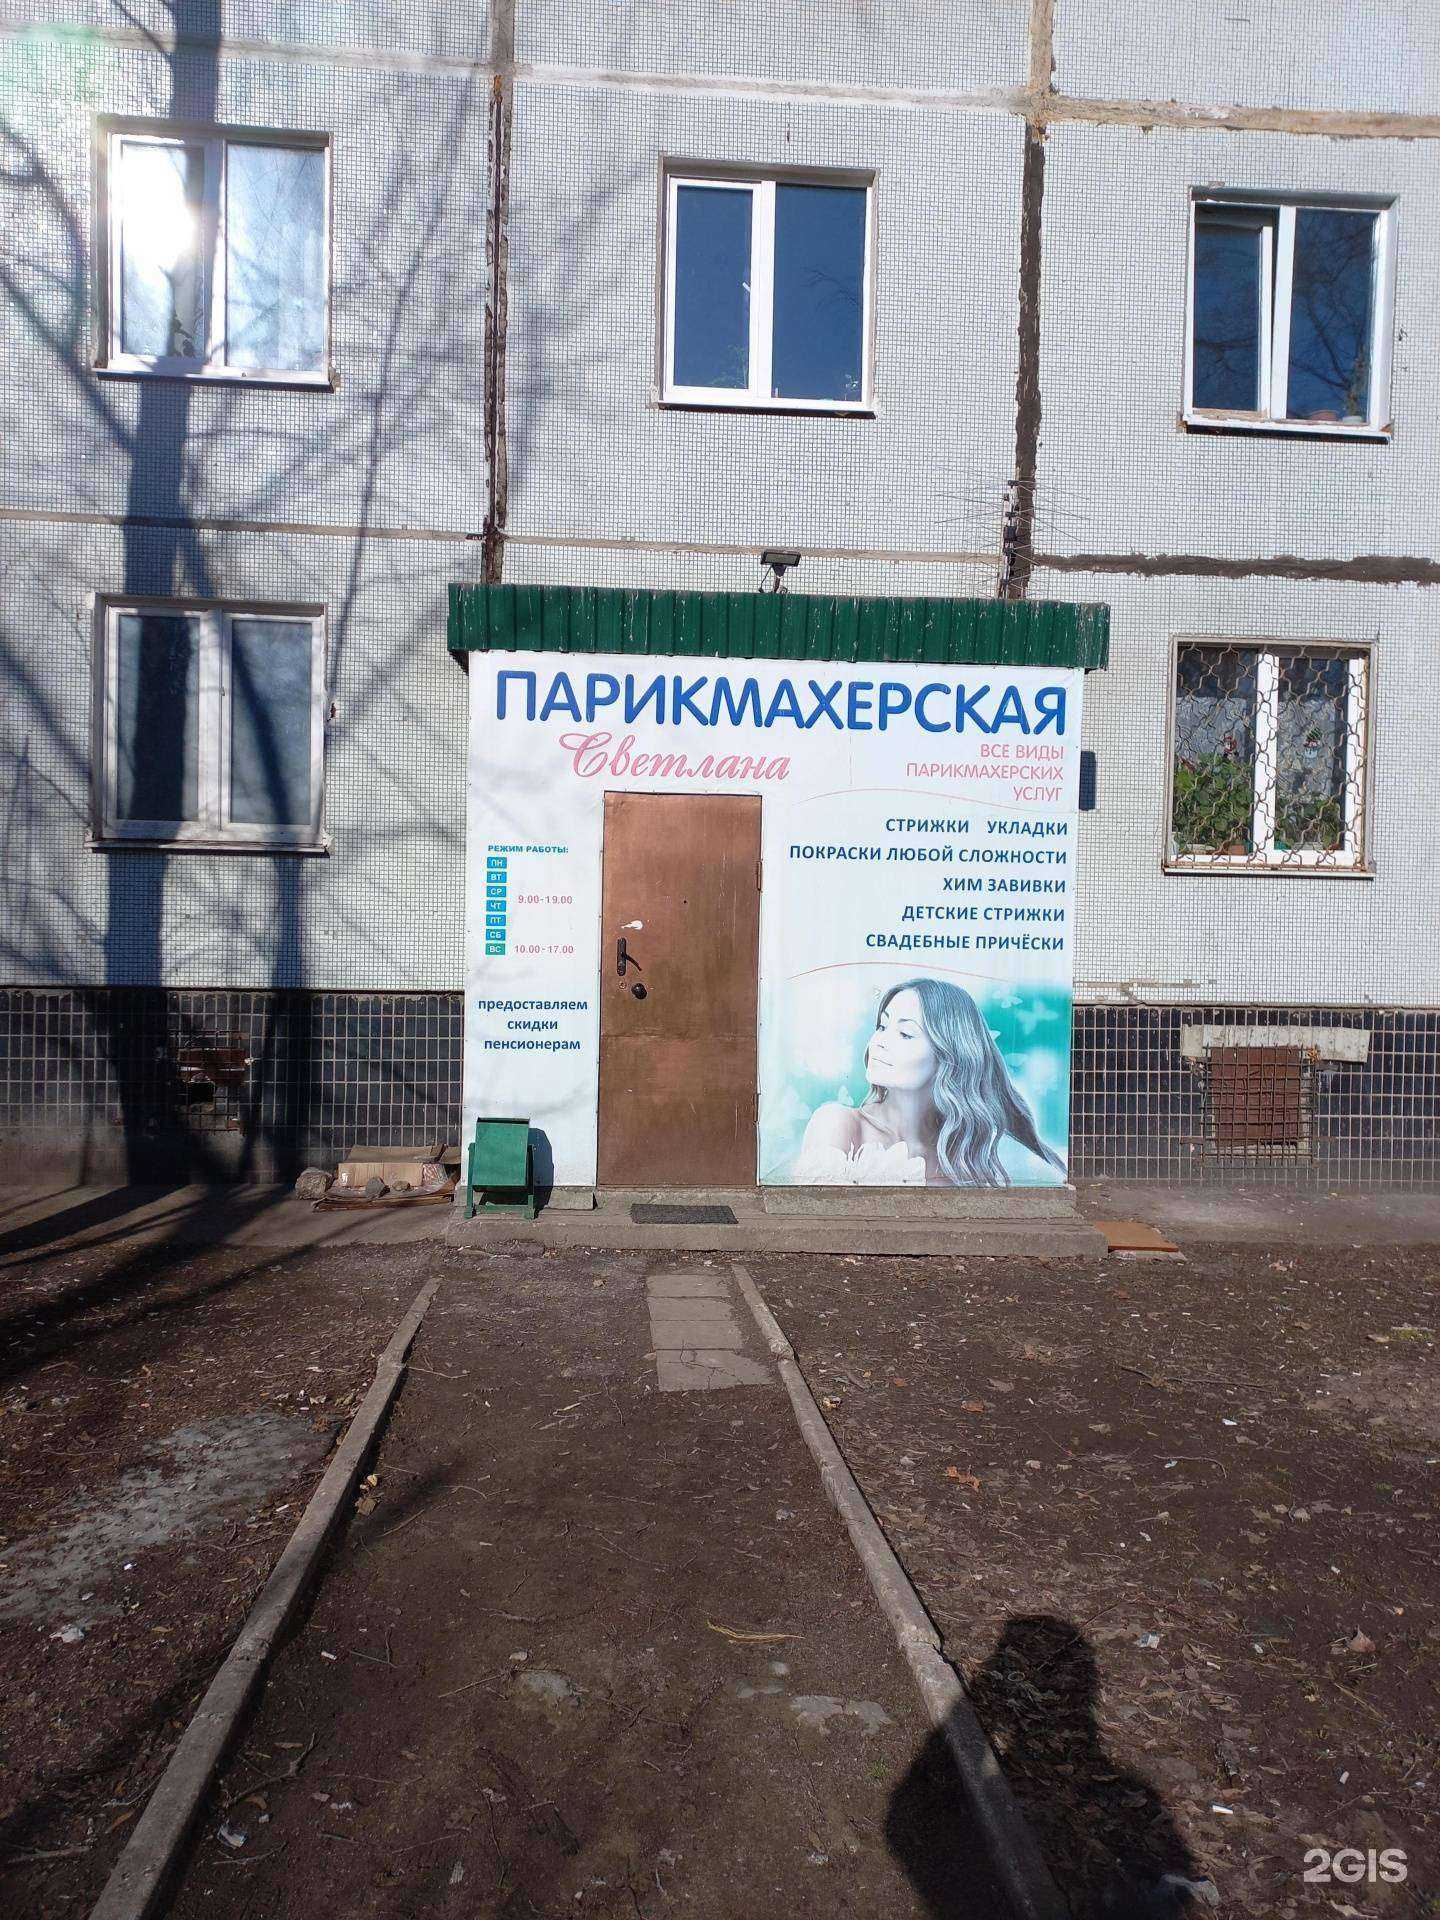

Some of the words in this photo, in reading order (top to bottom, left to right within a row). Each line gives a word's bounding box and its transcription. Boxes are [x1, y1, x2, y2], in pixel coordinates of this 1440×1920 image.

[496, 669, 1067, 736] ПАРИКМАХЕРСКАЯ
[558, 731, 791, 780] Светлана
[980, 743, 1010, 759] ВСЕ
[1015, 744, 1064, 761] ВИДЫ
[906, 762, 1064, 781] ПАРИКМАХЕРСКИХ
[1012, 785, 1063, 802] УСЛУГ
[885, 818, 969, 834] СТРИЖКИ
[987, 820, 1068, 837] УКЛАДКИ
[488, 845, 523, 853] РЕЖИМ
[526, 846, 569, 854] РАБОТЫ:
[790, 845, 881, 861] ПОКРАСКИ
[886, 845, 953, 863] ЛЮБОЙ
[958, 849, 1067, 865] СЛОЖНОСТИ
[491, 859, 503, 867] ПН
[490, 873, 502, 881] ВТ
[942, 877, 983, 892] ХИМ
[987, 878, 1066, 893] ЗАВИВКИ
[490, 888, 503, 897] СР
[490, 902, 502, 910] ЧТ
[518, 894, 573, 905] 9.00-19.00
[901, 905, 978, 922] ДЕТСКИЕ
[983, 907, 1065, 922] СТРИЖКИ
[490, 917, 502, 925] ПТ
[865, 933, 970, 950] СВАДЕБНЫЕ
[975, 934, 1064, 951] ПРИЧЁСКИ
[489, 945, 501, 953] ВС
[514, 944, 575, 954] 10.00-17.00
[478, 1000, 588, 1013] предоставляем
[507, 1020, 558, 1031] скидки
[484, 1040, 581, 1053] пенсионерам
